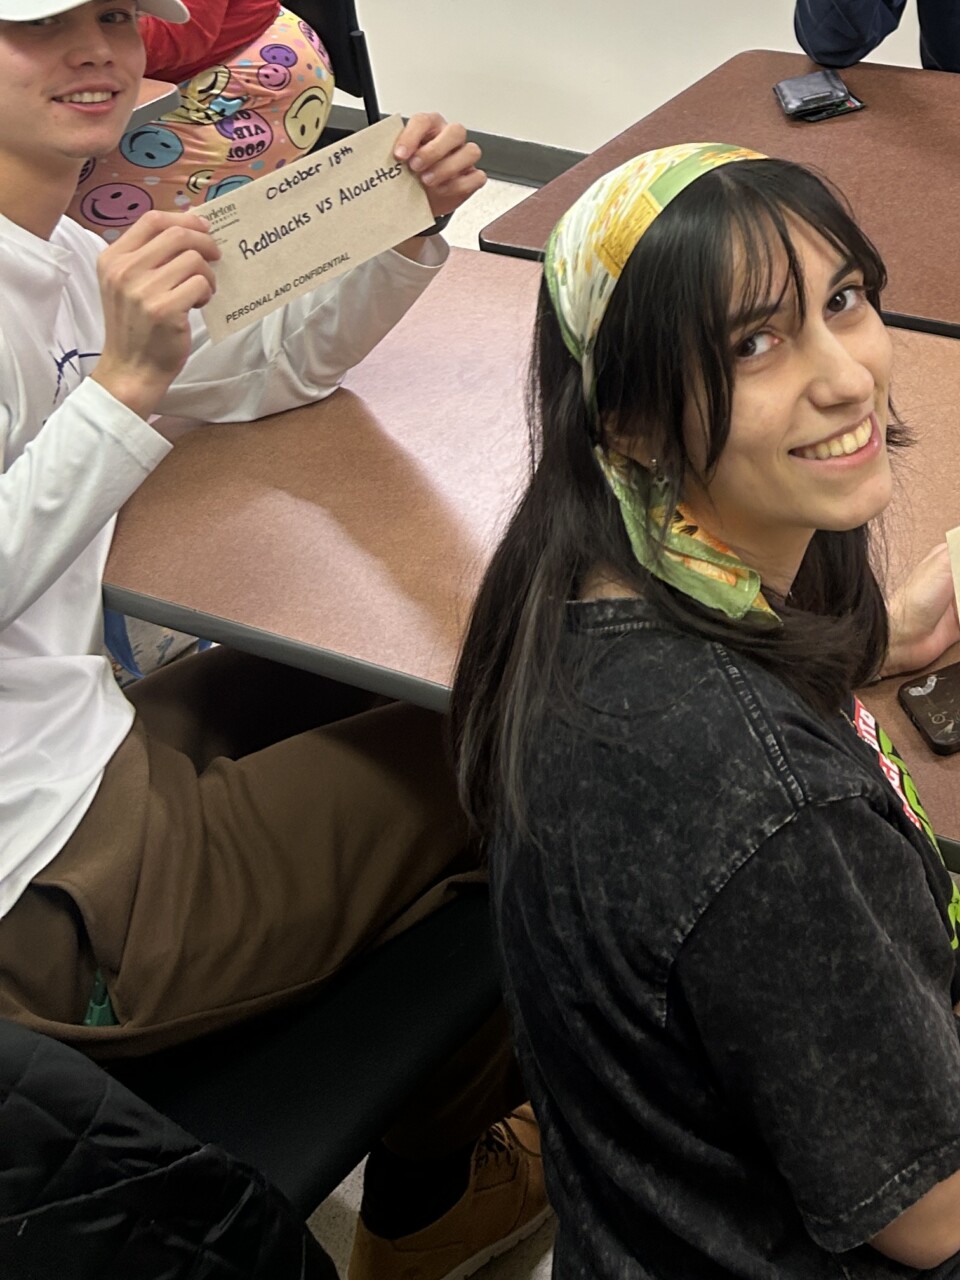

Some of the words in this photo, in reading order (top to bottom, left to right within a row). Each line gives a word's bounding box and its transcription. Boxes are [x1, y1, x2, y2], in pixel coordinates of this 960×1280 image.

[266, 162, 323, 200] October
[328, 145, 353, 168] 18th
[238, 210, 312, 260] Redblacks
[316, 197, 333, 214] vs
[340, 162, 403, 205] Alouettes
[225, 293, 273, 324] PERSONAL
[274, 282, 292, 298] AND
[293, 252, 351, 288] CONFIDENTIAL
